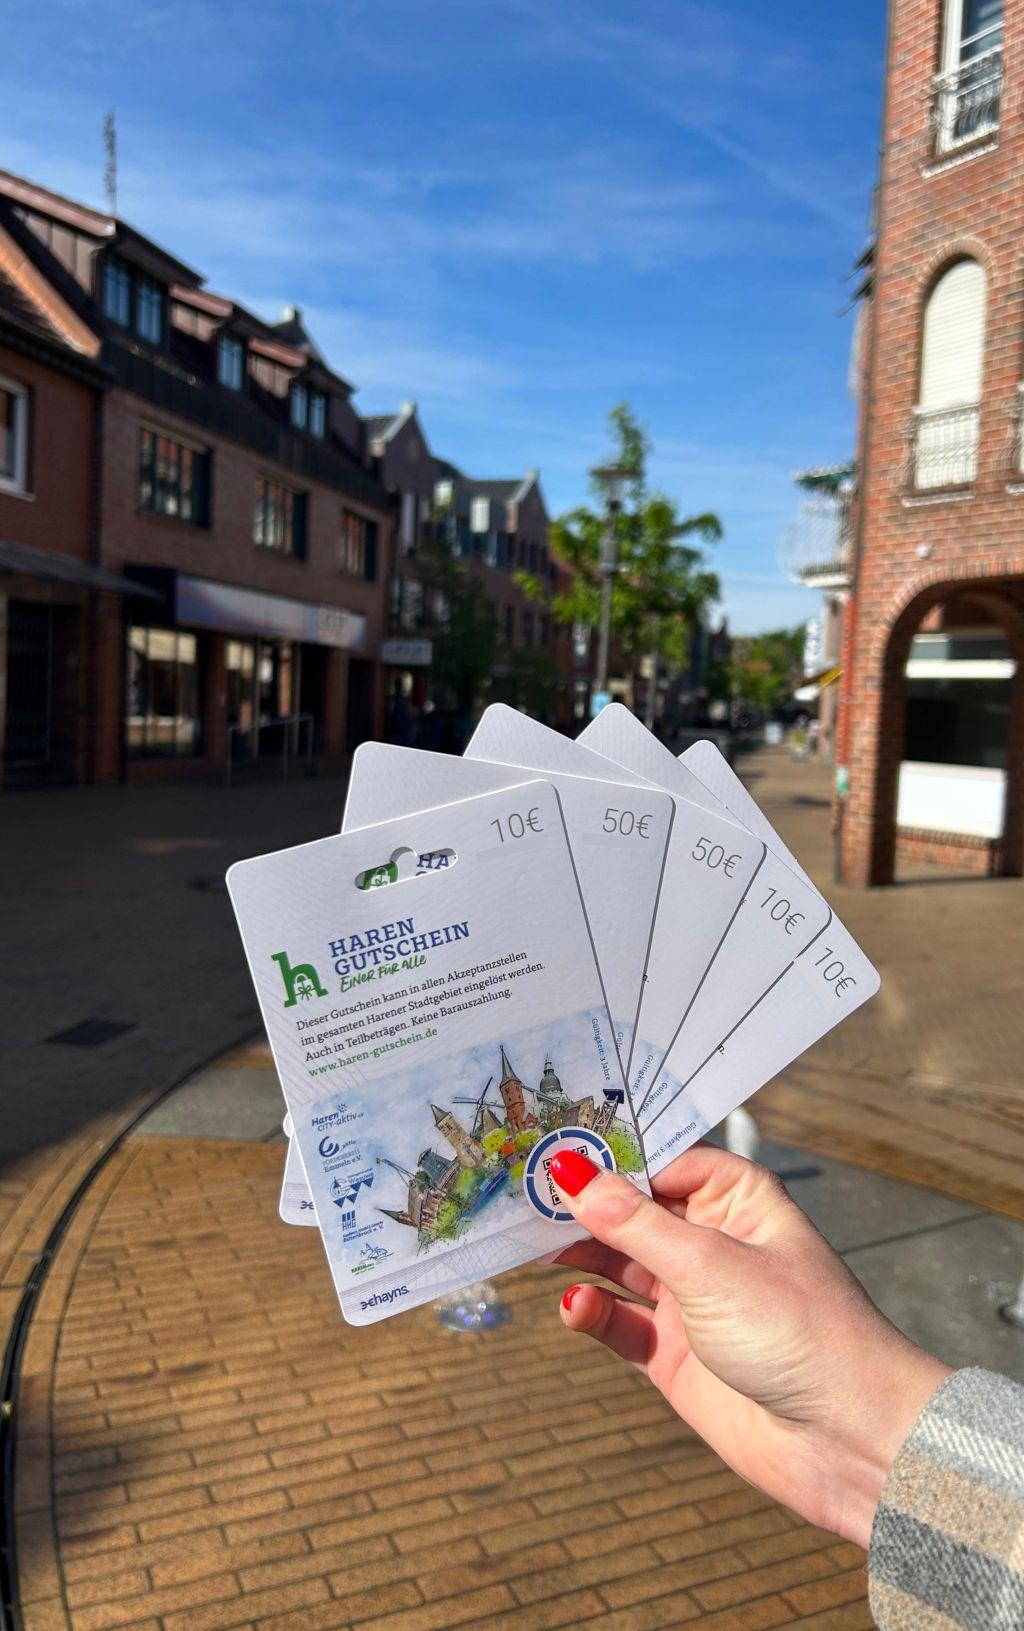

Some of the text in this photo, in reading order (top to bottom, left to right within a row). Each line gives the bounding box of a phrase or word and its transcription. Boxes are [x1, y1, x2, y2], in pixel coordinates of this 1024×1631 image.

[490, 807, 544, 842] 10€
[602, 807, 654, 839] 50€
[691, 836, 743, 878] 50€
[761, 887, 806, 935] 10€
[328, 917, 415, 958] HAREN
[334, 921, 470, 976] GUTSCHEIN
[296, 951, 528, 1031] Dieser Gutschein kann in allen Akzeptanzstellen
[815, 947, 857, 998] 10€
[301, 962, 546, 1047] im gesamten Harener Stadtgebiet eingelöst werden.
[305, 988, 513, 1062] Auch in Teilbeträgen. Keine Barauszahlung.
[308, 1027, 438, 1077] www.haren-gutschein.de
[312, 1112, 339, 1126] Haren
